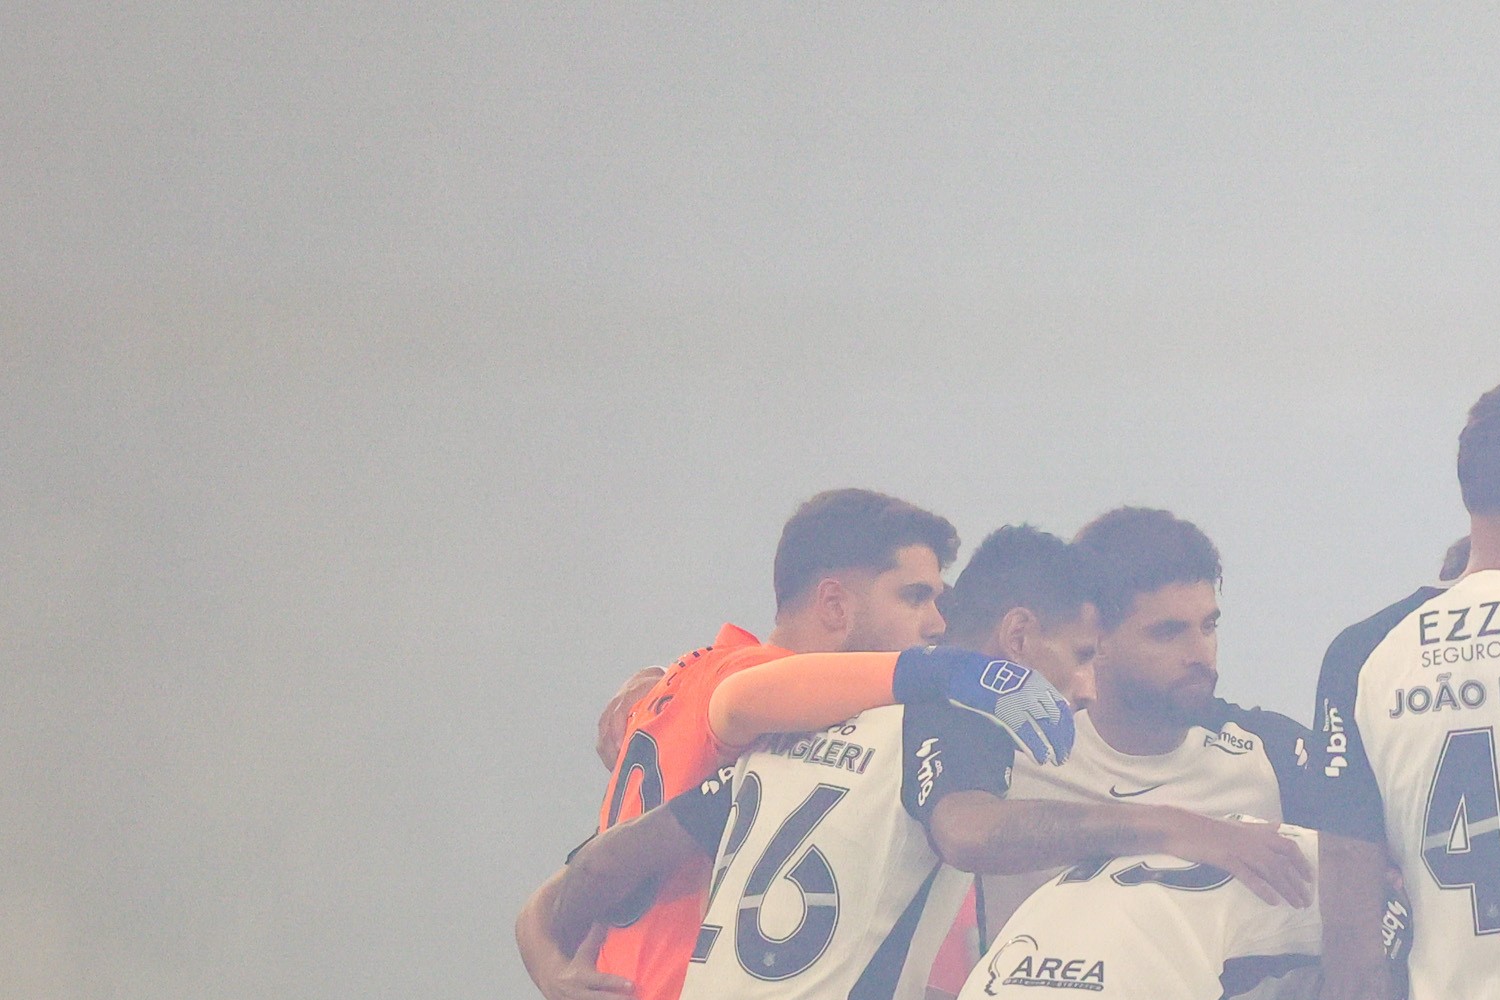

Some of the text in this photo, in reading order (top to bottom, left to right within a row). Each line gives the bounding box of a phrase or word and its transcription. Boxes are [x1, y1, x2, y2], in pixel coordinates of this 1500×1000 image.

[1388, 673, 1488, 719] JOÃO
[1203, 731, 1254, 751] Fmesa
[690, 770, 850, 981] 26
[1008, 955, 1104, 983] AREA
